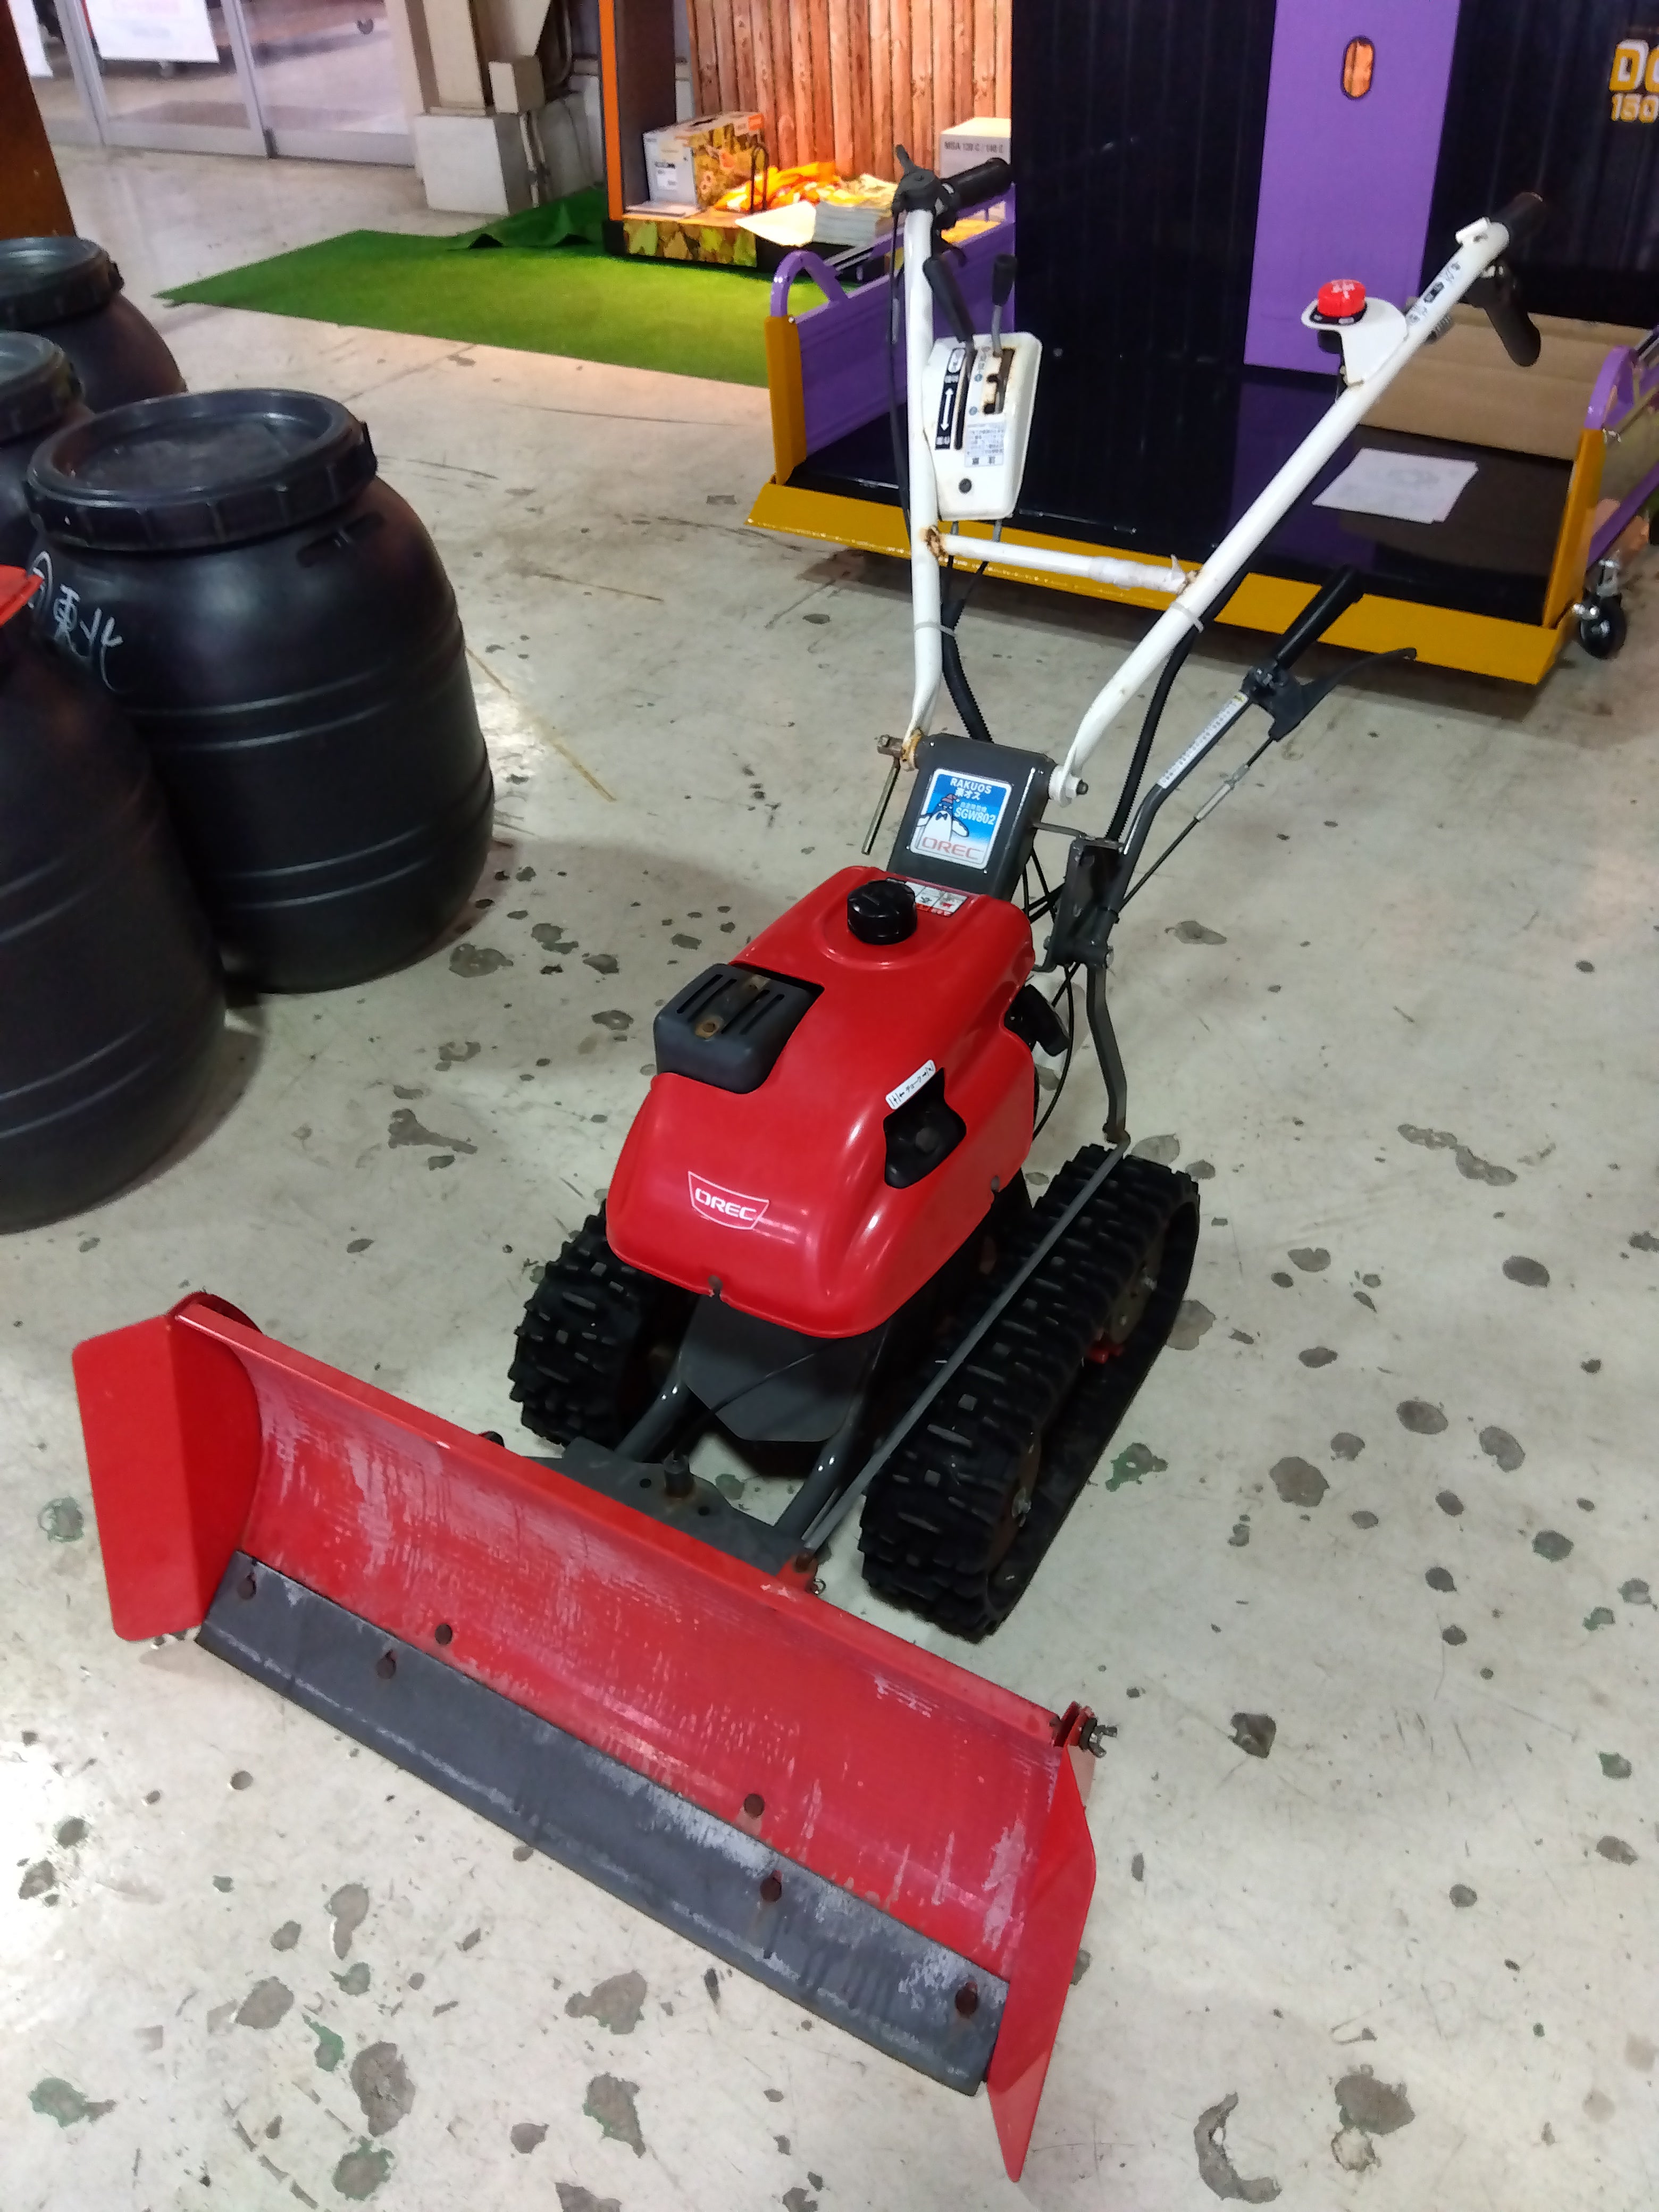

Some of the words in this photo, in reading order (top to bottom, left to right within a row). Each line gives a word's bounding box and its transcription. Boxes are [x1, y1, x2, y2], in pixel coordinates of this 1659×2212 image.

[950, 777, 992, 794] RAKUOS
[954, 807, 996, 825] SGW802
[922, 836, 984, 860] OREC
[695, 1187, 757, 1221] OREC
